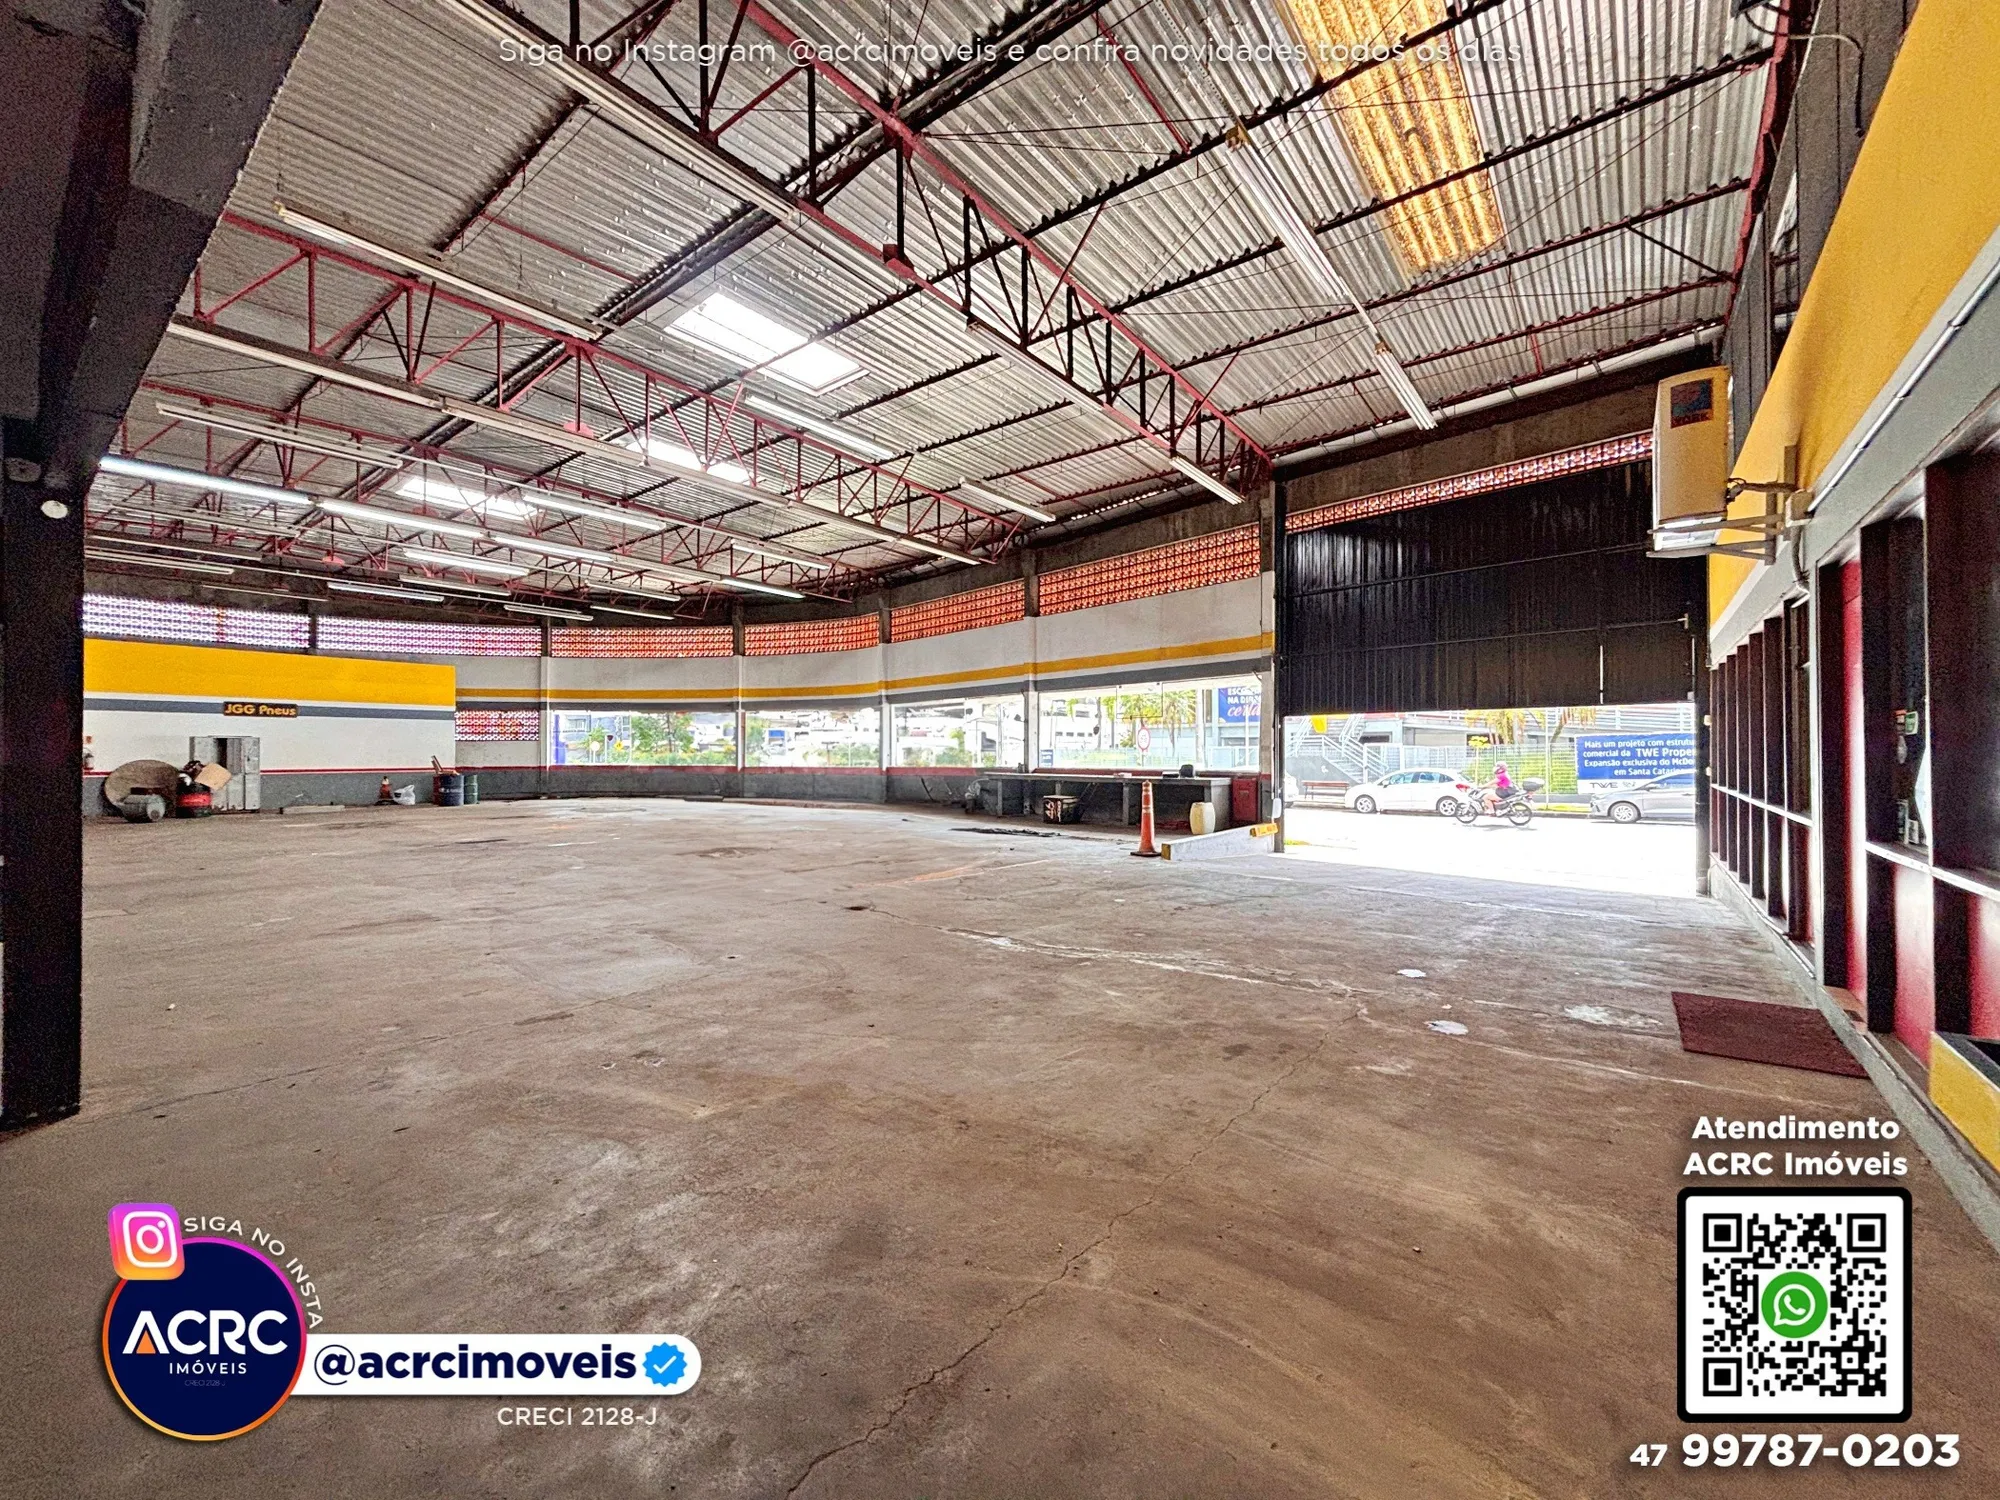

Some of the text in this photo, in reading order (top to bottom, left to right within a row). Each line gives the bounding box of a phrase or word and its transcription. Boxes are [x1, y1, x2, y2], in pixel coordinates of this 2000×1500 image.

[225, 703, 297, 716] JGG Pneus
[1584, 740, 1601, 749] Mais
[1618, 739, 1646, 748] projeto
[1583, 750, 1618, 758] comercial
[1621, 749, 1631, 757] da
[1636, 748, 1659, 757] TWE
[1584, 759, 1620, 768] Expansão
[1623, 758, 1657, 766] exclusiva
[1660, 758, 1670, 766] do
[1628, 768, 1651, 776] Santa
